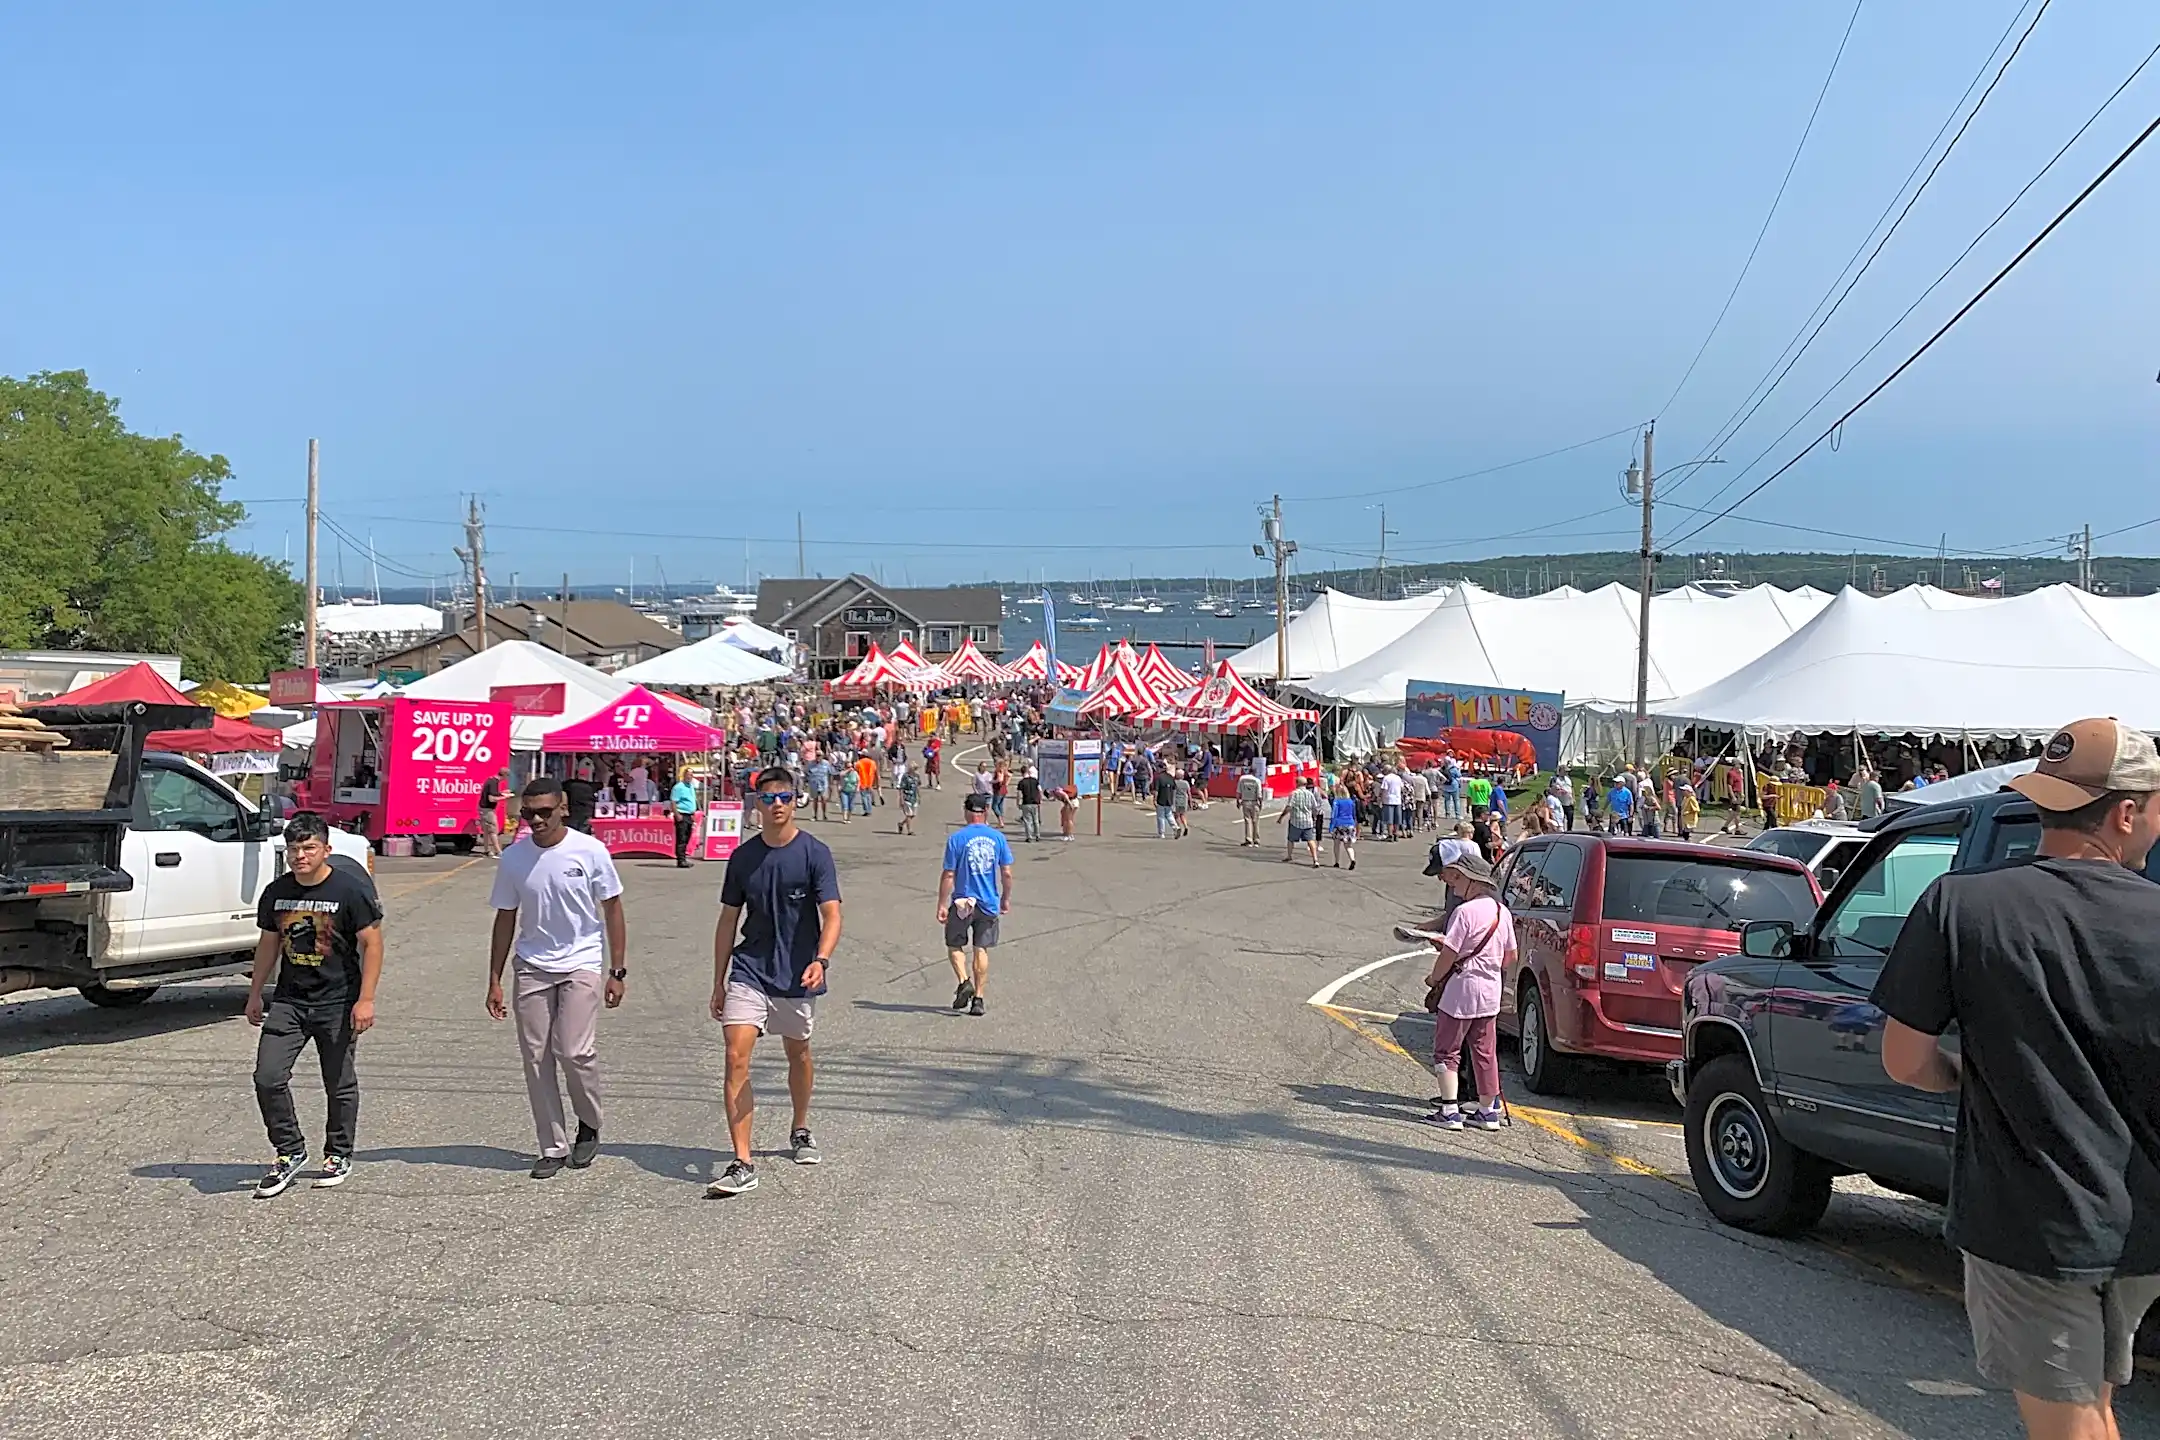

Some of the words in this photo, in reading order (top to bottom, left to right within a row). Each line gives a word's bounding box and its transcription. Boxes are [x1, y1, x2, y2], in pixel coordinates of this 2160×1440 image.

[845, 609, 864, 622] The
[867, 609, 892, 623] Pearl
[412, 711, 450, 726] SAVE
[452, 713, 473, 727] UP
[475, 714, 494, 728] TO
[1454, 695, 1533, 726] MAINE
[411, 726, 492, 763] 20%
